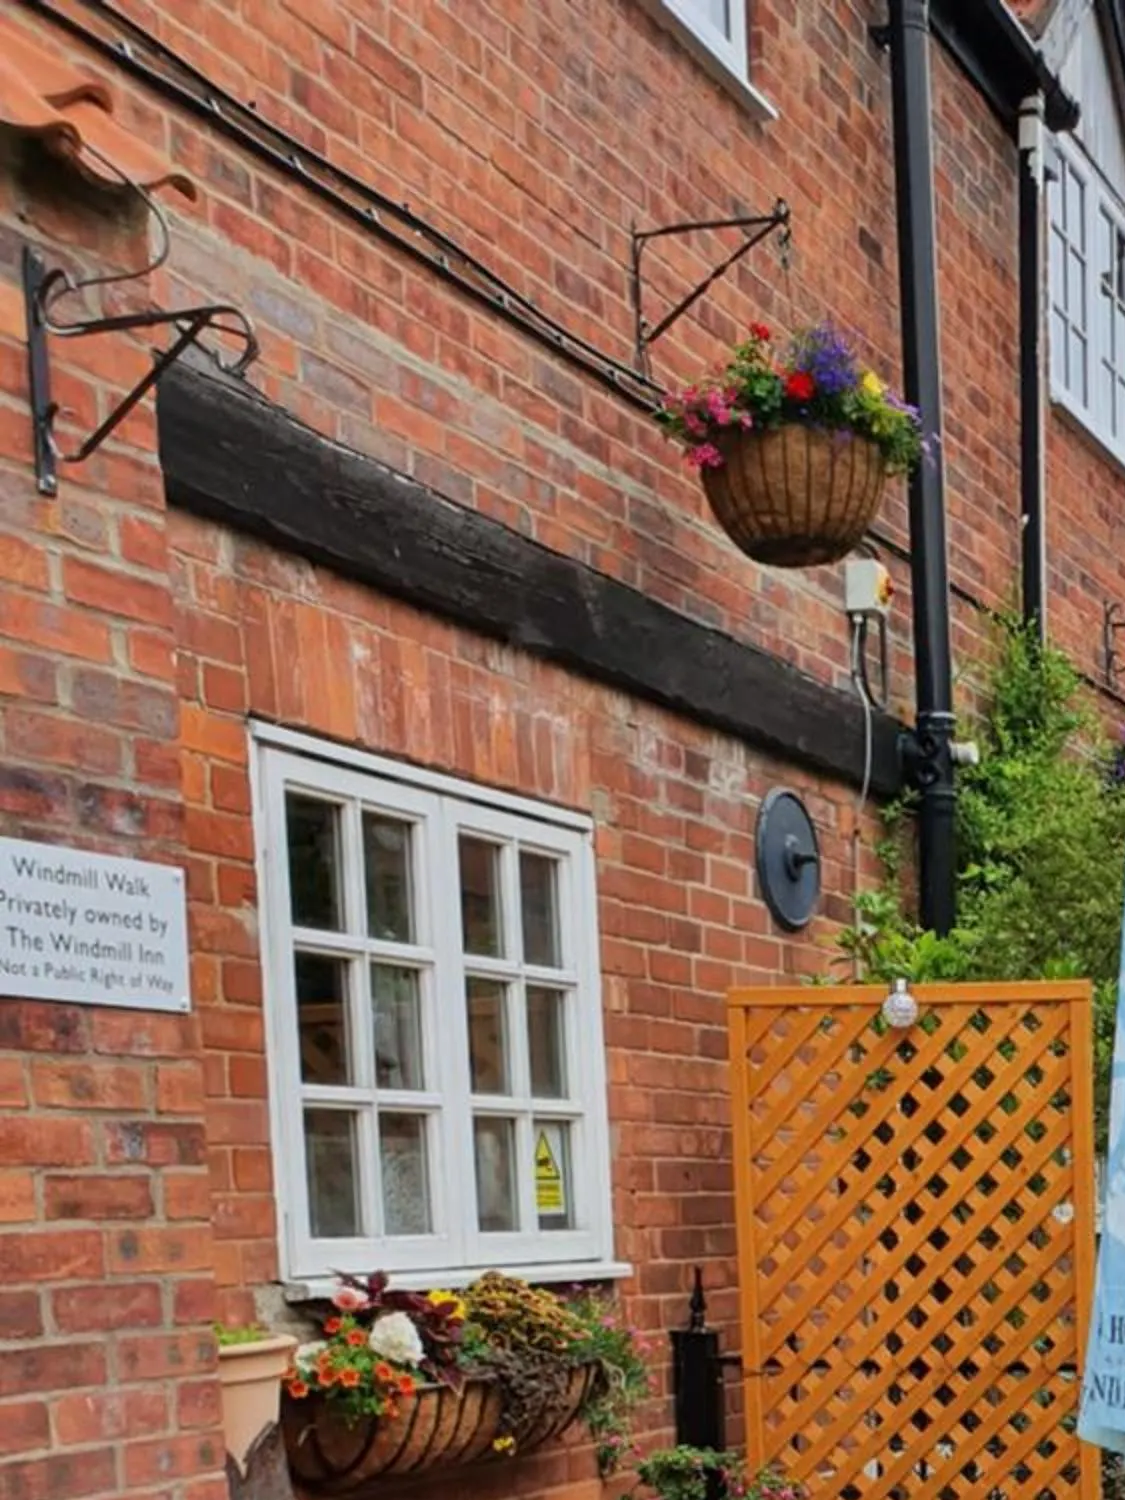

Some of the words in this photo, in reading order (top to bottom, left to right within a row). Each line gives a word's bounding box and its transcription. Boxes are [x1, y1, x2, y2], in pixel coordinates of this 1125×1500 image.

[12, 854, 99, 890] Windmill
[84, 908, 143, 931] owned
[149, 914, 168, 938] by
[6, 926, 43, 950] The
[50, 932, 133, 960] Windmill
[139, 943, 165, 965] Inn
